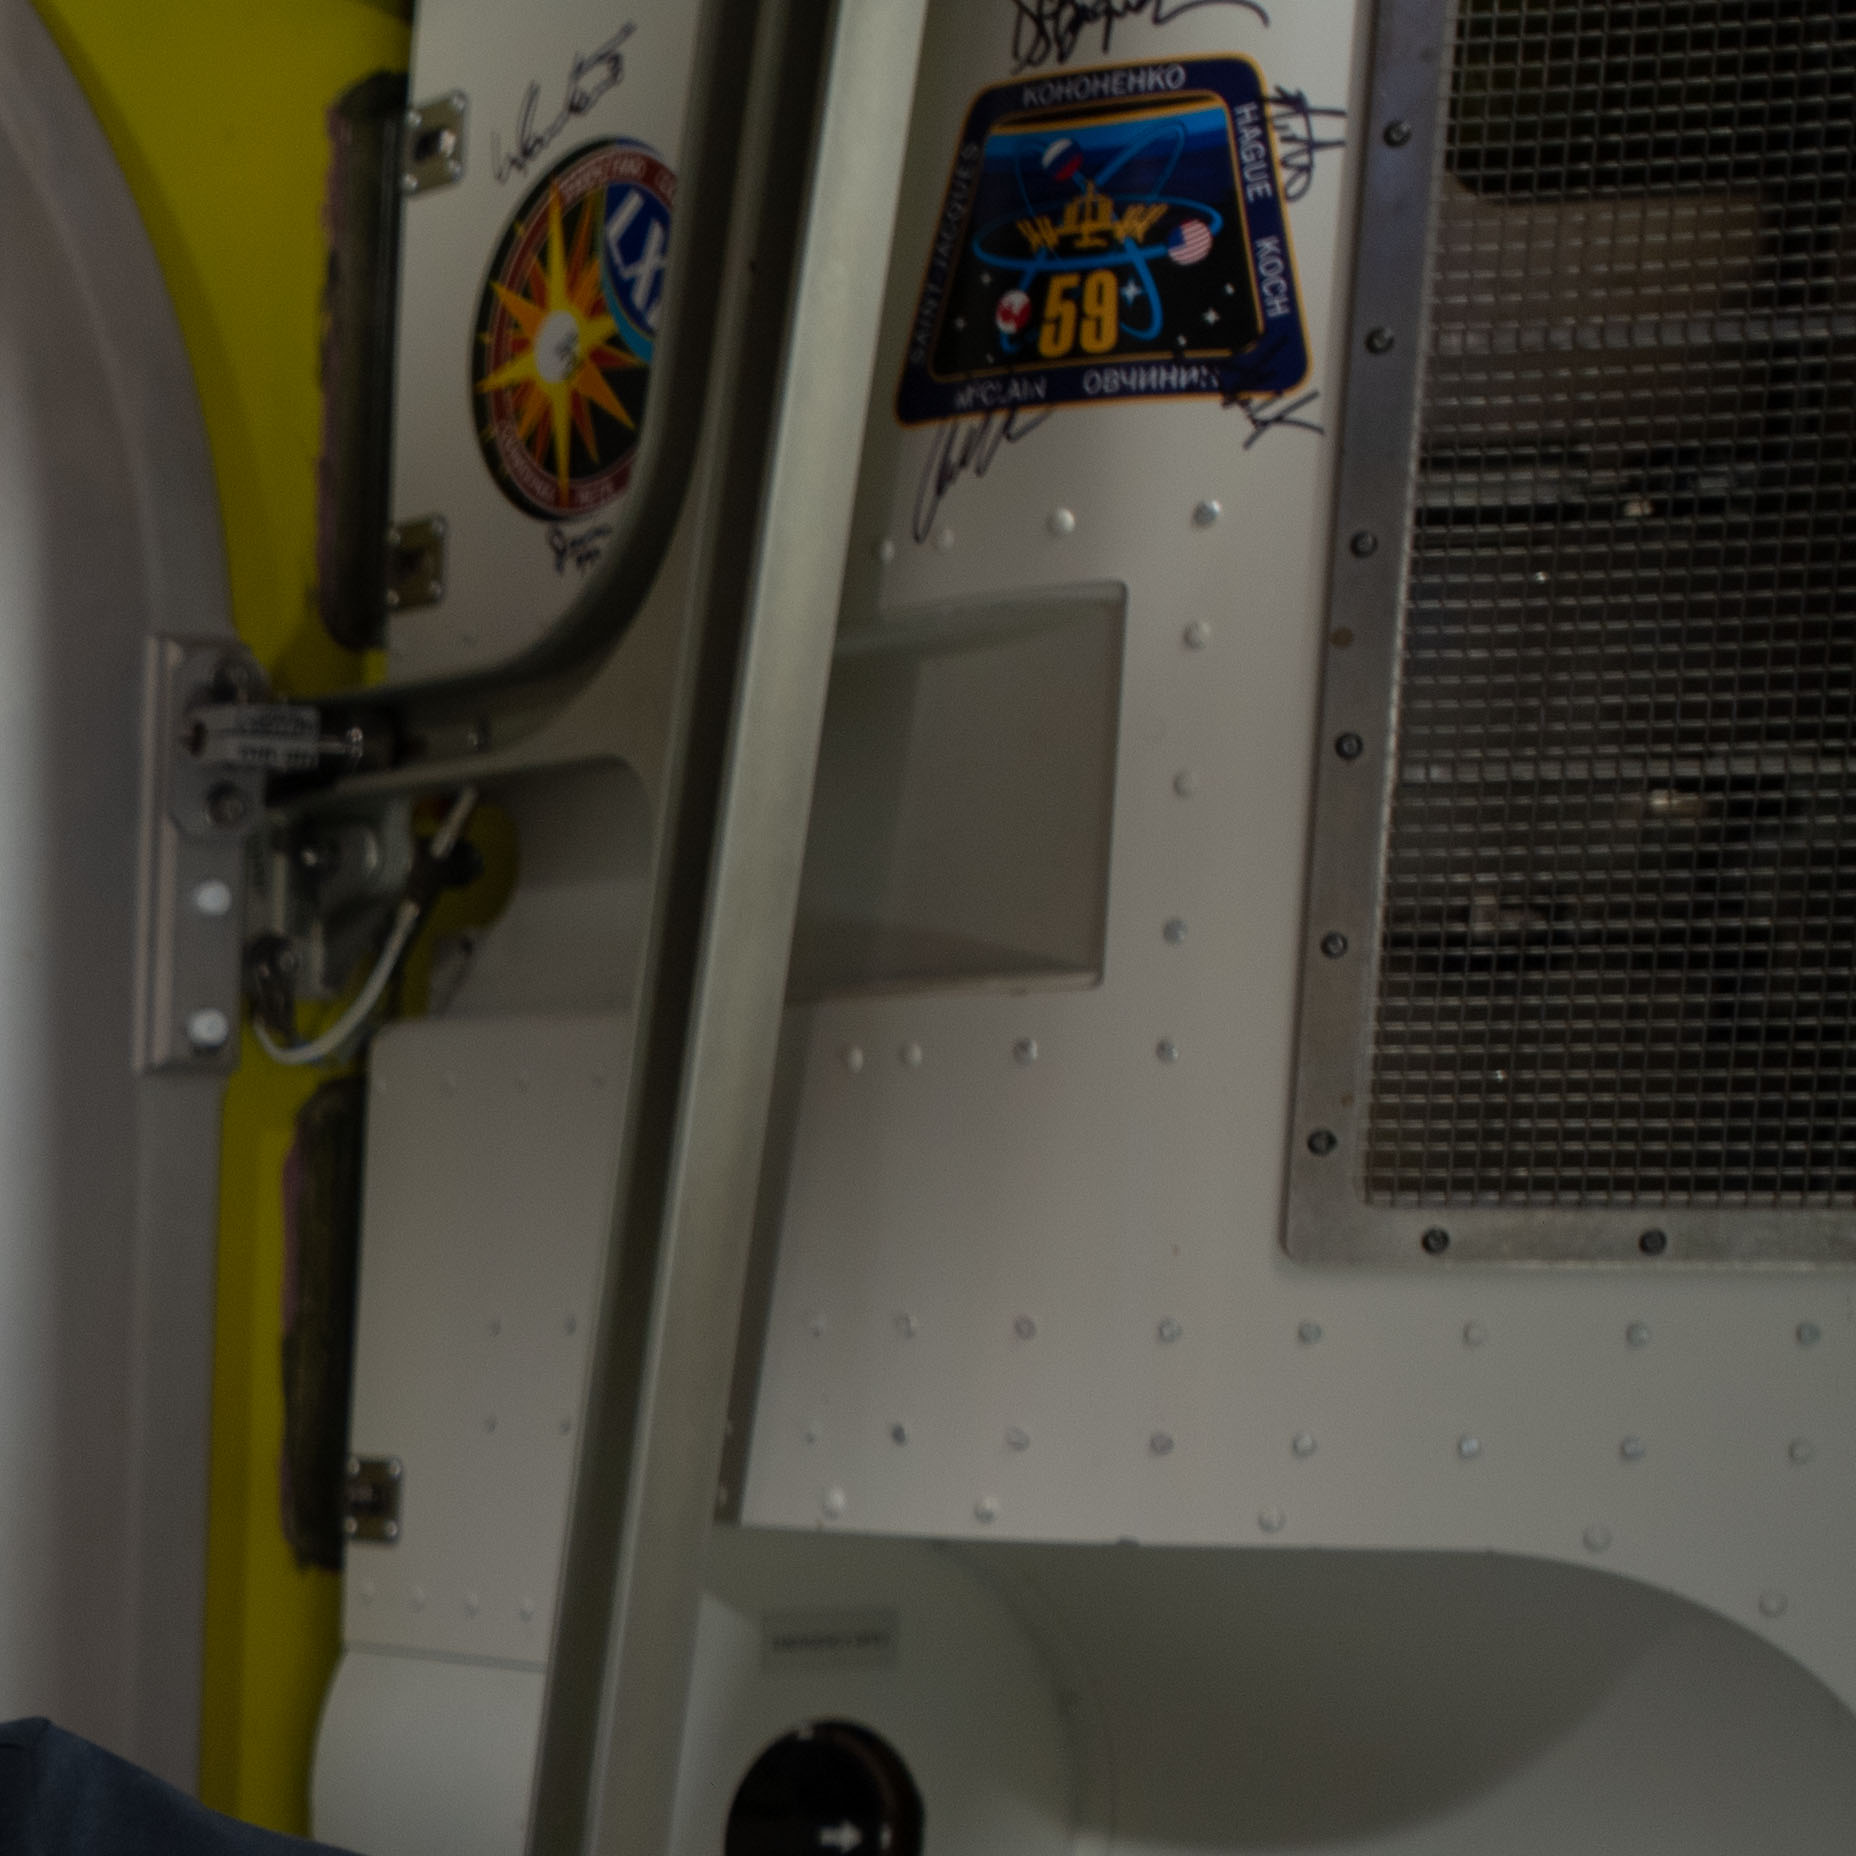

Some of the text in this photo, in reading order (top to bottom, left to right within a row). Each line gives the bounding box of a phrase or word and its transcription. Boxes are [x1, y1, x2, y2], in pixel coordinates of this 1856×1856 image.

[1023, 63, 1186, 108] КОНОНЕНКО
[1235, 102, 1290, 318] HAGUE KOCH
[1039, 270, 1119, 358] 59
